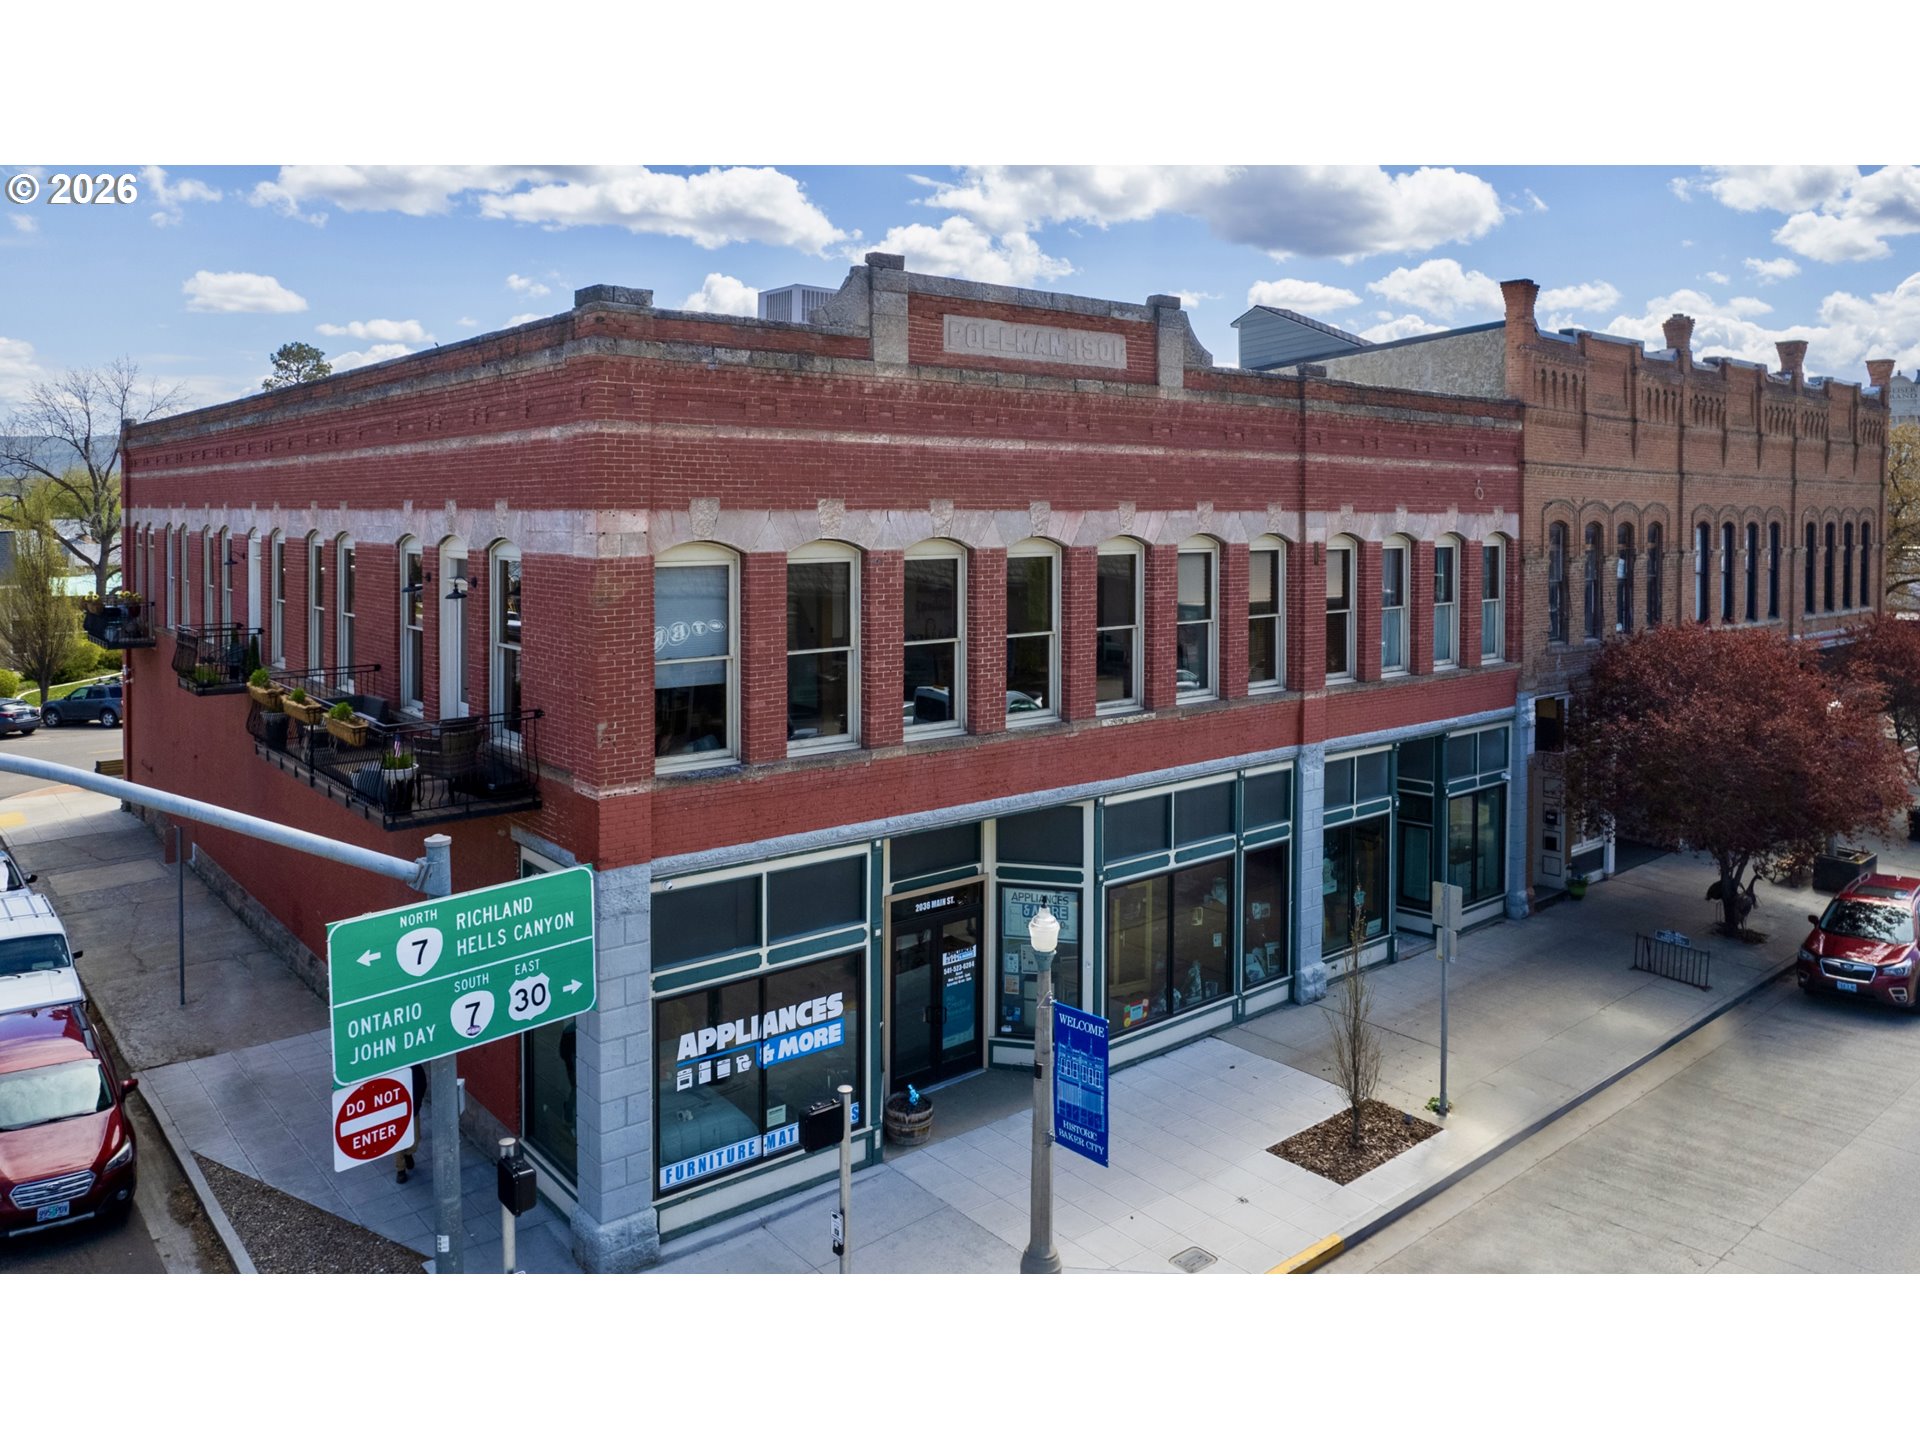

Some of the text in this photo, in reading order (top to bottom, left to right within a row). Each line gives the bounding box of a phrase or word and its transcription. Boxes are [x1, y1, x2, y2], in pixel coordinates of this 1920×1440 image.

[948, 320, 1065, 357] POLLMAN
[456, 896, 533, 930] RICHLAND
[931, 897, 946, 908] MAIN
[1031, 904, 1068, 920] MRE
[400, 909, 438, 928] NORTH
[456, 911, 575, 957] HELLS CANYON
[411, 939, 429, 966] 7
[515, 958, 541, 976] EAST
[454, 973, 490, 993] SOUTH
[514, 982, 547, 1013] 30
[348, 1002, 422, 1038] ONTARIO
[465, 1001, 481, 1027] 7
[676, 992, 844, 1062] APPLIANCES
[1059, 1012, 1105, 1038] WELCOME
[350, 1024, 437, 1065] JOHN DAY
[759, 1022, 842, 1065] & MORE
[346, 1087, 401, 1117] DO NOT
[352, 1124, 397, 1150] ENTER
[1058, 1127, 1104, 1155] BAKER CITY
[1063, 1119, 1098, 1141] HISTORIC
[665, 1140, 755, 1185] FURNITURE
